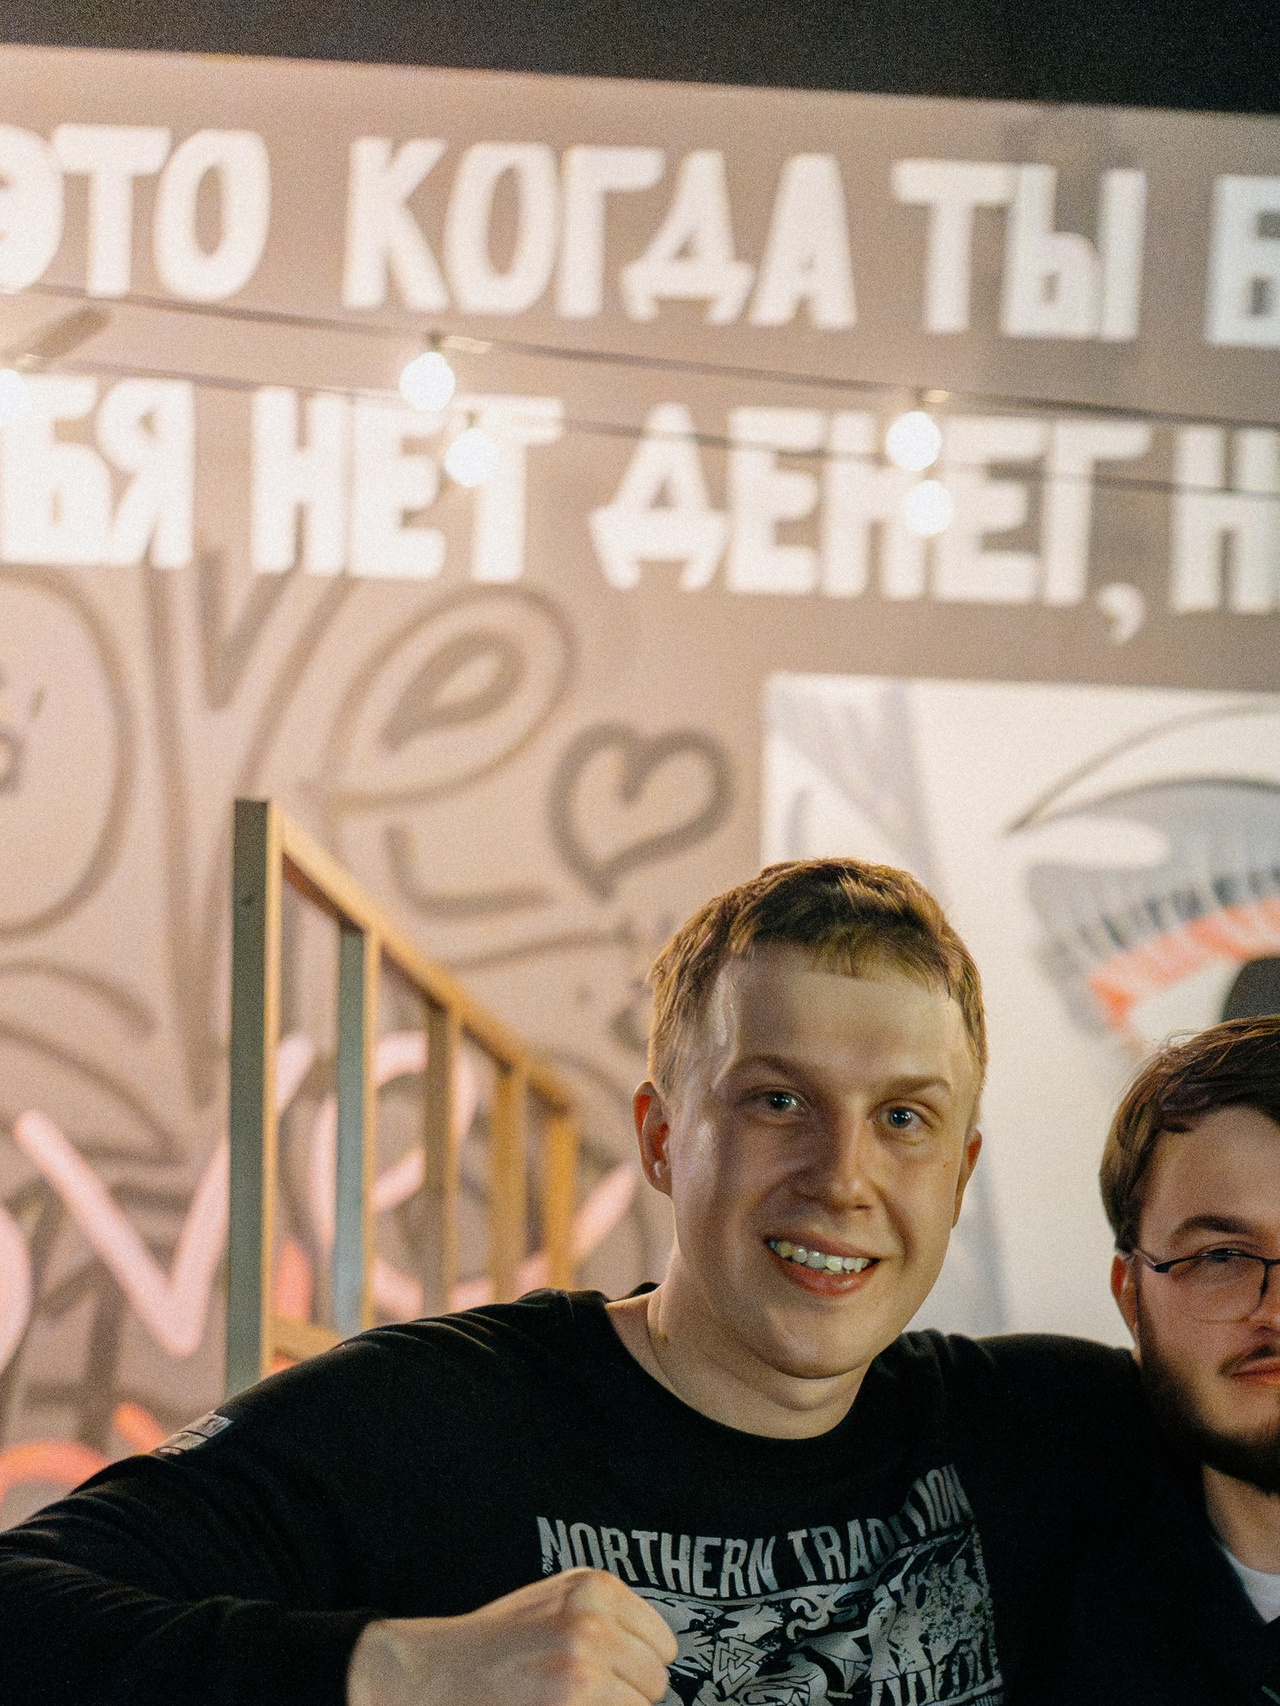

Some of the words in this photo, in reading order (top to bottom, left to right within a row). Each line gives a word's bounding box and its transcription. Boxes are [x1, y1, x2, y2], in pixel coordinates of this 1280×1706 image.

[341, 136, 858, 331] КОГДА
[890, 158, 1149, 344] ТЫ
[251, 386, 565, 584] НЕТ
[535, 1515, 777, 1599] NORTHERN
